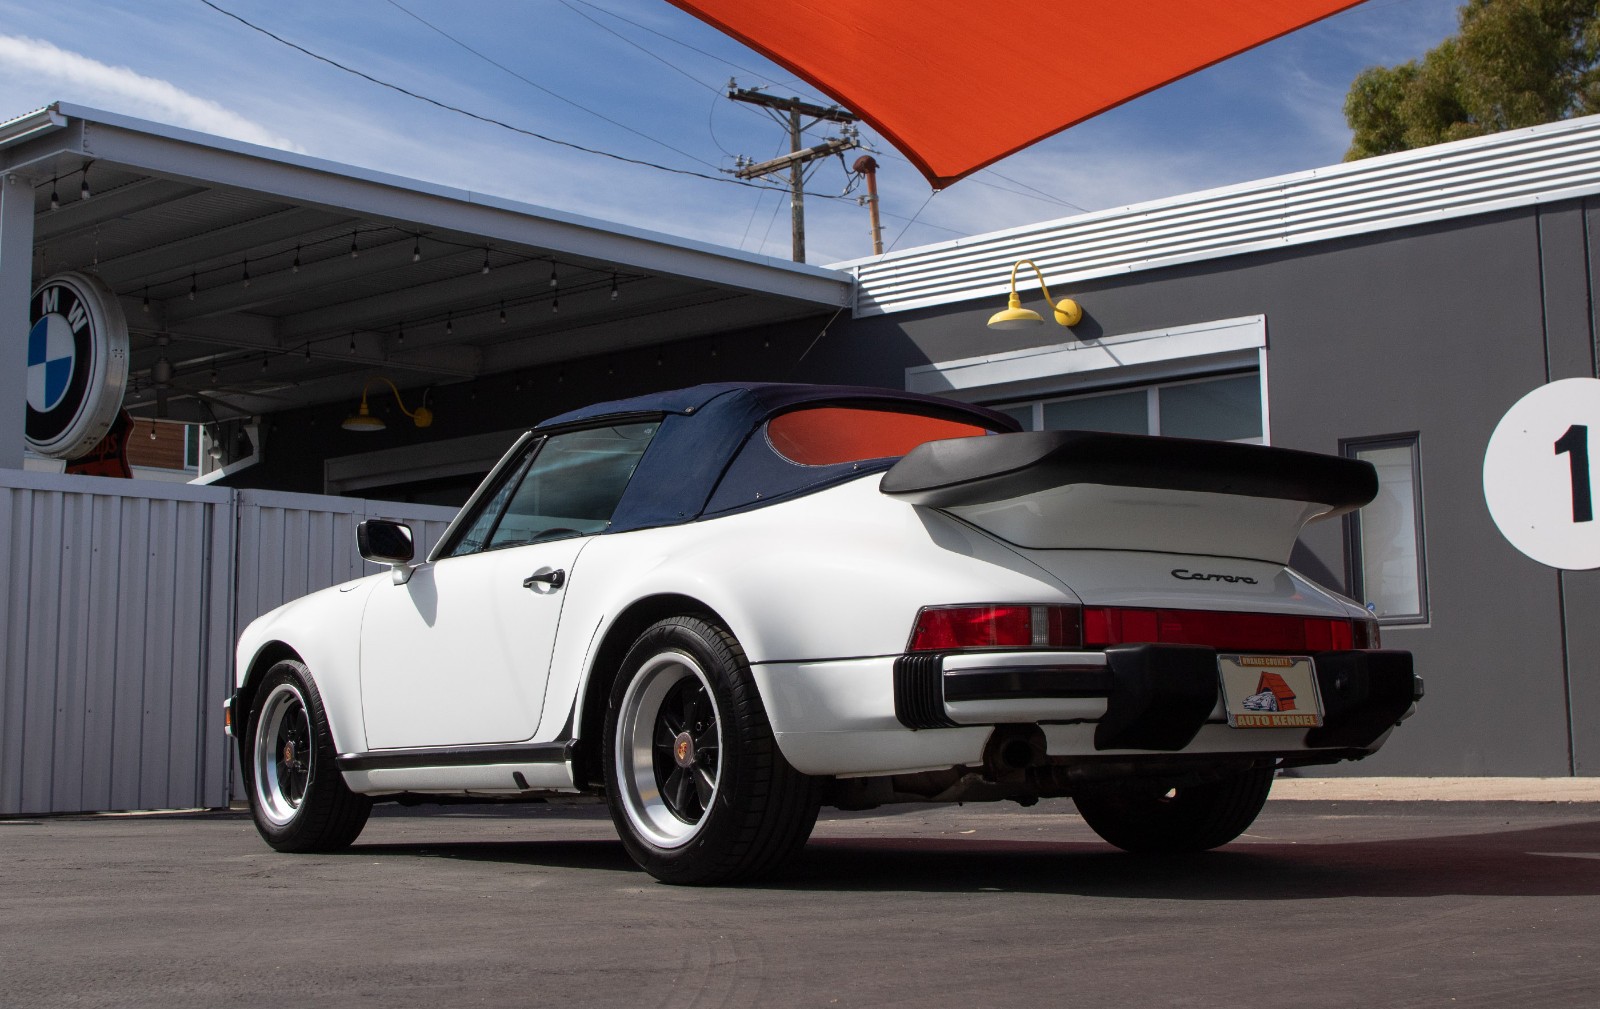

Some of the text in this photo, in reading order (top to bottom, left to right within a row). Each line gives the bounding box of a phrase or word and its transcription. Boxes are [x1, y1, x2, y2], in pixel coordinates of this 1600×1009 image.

[29, 286, 88, 334] MW
[1554, 424, 1593, 523] 1
[1171, 569, 1258, 584] Carrera
[1242, 657, 1288, 666] ORANGE COUNTY
[1237, 715, 1316, 726] AUTO KENNEL
